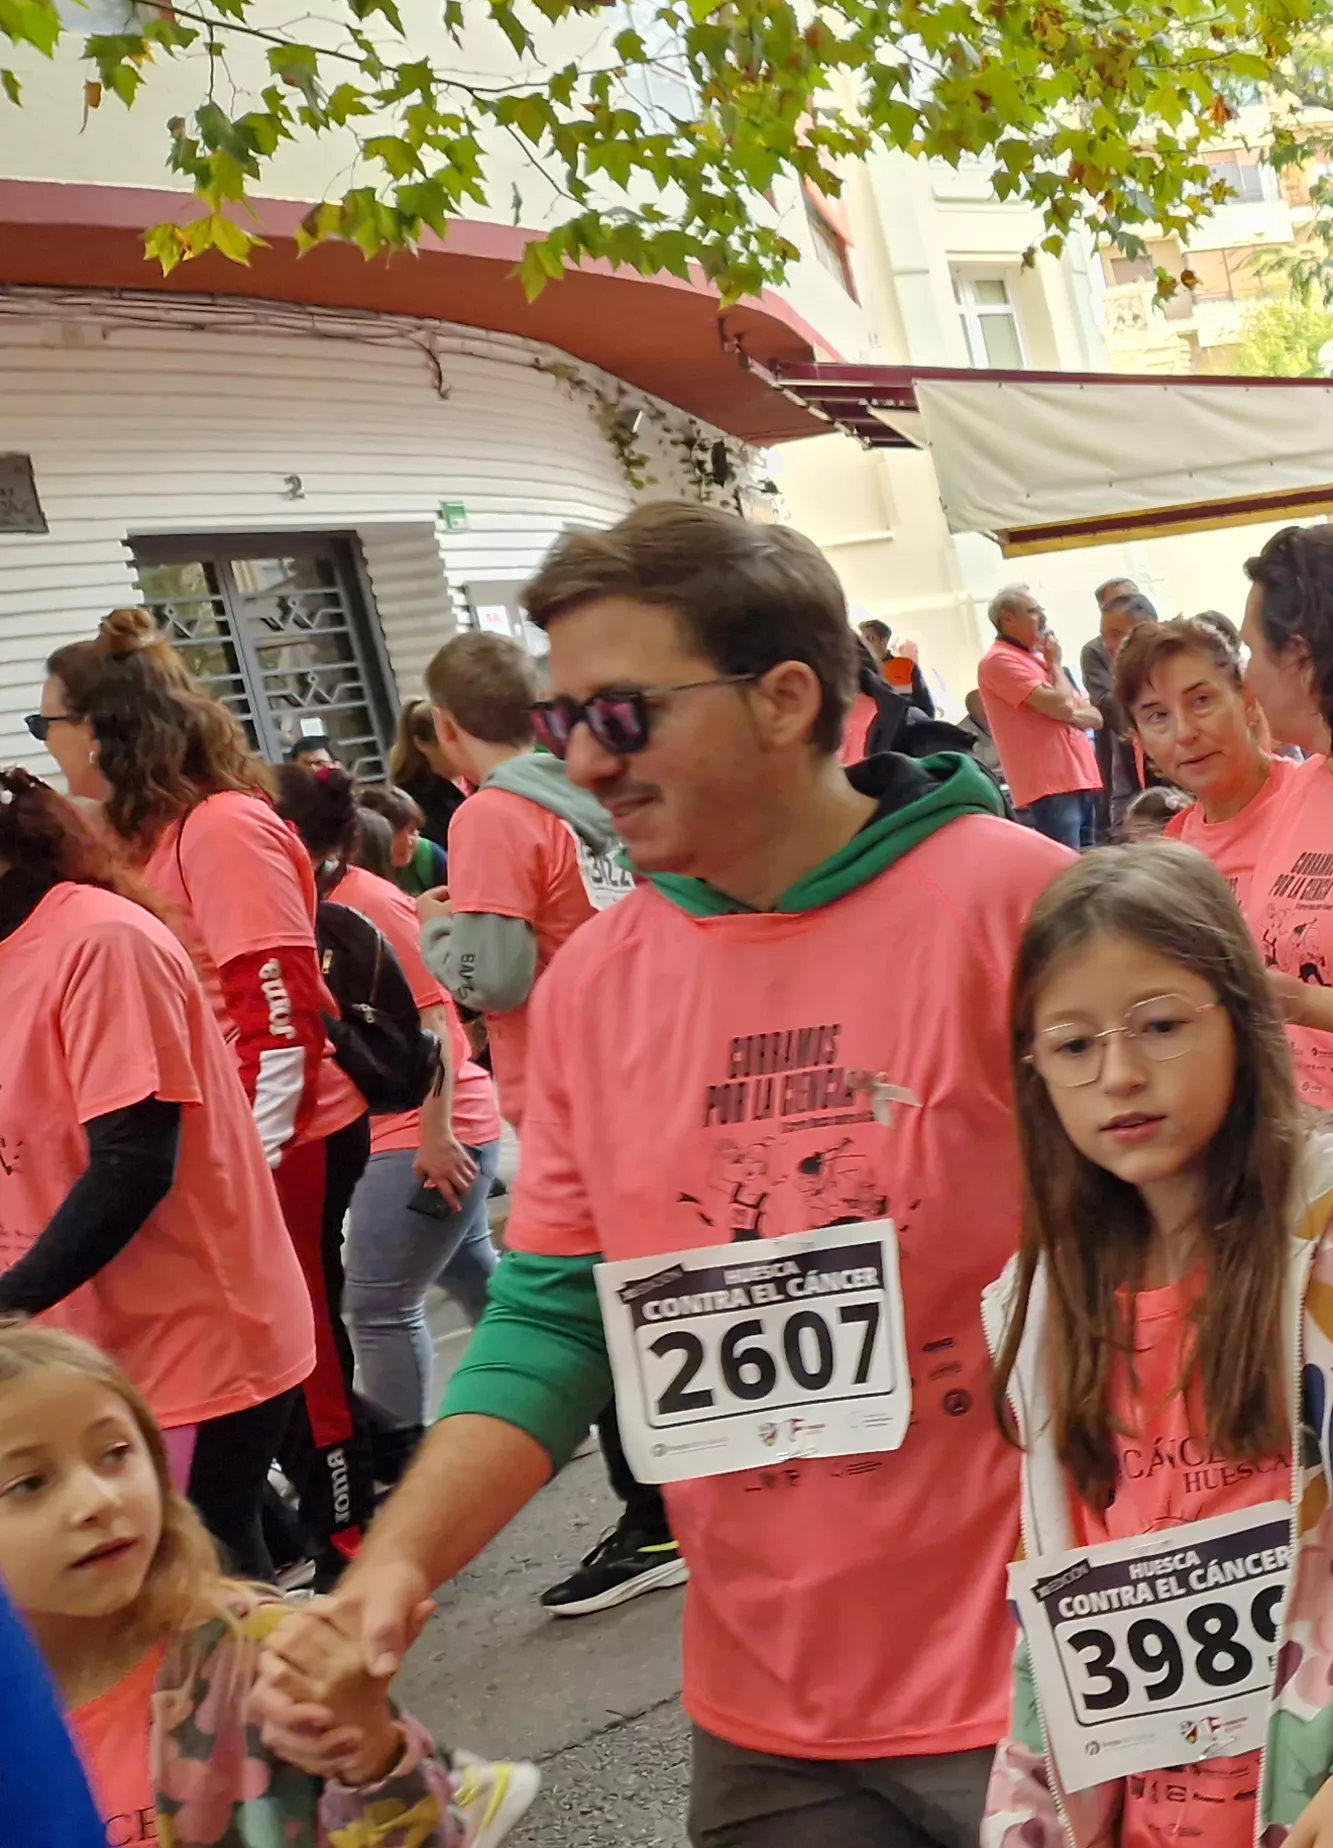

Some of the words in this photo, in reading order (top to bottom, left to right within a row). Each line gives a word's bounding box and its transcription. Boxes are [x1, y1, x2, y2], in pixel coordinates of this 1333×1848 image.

[641, 1288, 751, 1321] CONTRA
[751, 1284, 785, 1304] EL
[786, 1267, 880, 1297] CÁNCER
[723, 1260, 800, 1286] HUESCA
[649, 1302, 881, 1415] 2607
[1057, 1582, 1156, 1619] CONTRA
[1155, 1577, 1187, 1601] EL
[1188, 1546, 1293, 1591] CÁNCER
[1128, 1550, 1201, 1581] HUESCA
